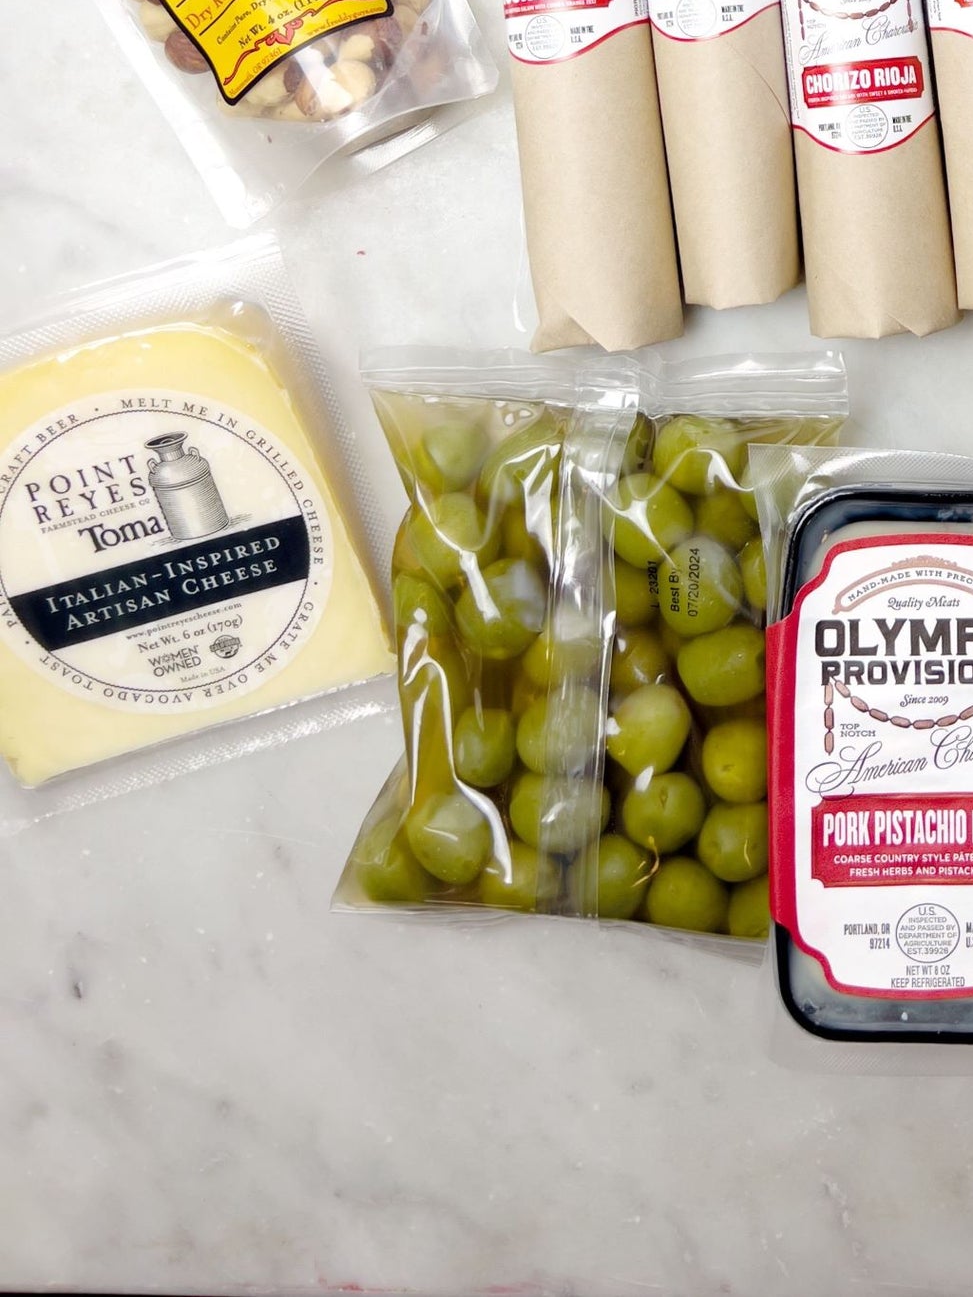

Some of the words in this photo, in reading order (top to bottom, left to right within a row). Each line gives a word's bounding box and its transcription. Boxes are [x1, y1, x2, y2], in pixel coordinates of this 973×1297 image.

[185, 6, 216, 31] Dry
[238, 34, 252, 49] Net
[250, 22, 266, 37] Wt.
[277, 7, 294, 19] oz.
[806, 68, 871, 94] CHORIZO
[874, 65, 917, 88] RIOJA
[121, 397, 172, 409] MELT
[25, 454, 138, 503] POINT
[32, 477, 147, 524] REYES
[78, 515, 165, 553] Toma
[46, 536, 281, 614] ITALIAN-INSPIRED
[688, 548, 700, 617] 07/20/2024
[65, 588, 171, 632] ARTISAN
[182, 558, 279, 597] CHEESE
[887, 597, 923, 611] Quality
[925, 597, 960, 608] Meats
[125, 601, 243, 641] www.pointreyescheese.com
[823, 811, 871, 847] PORK
[874, 808, 968, 846] PISTACHIO
[834, 854, 873, 864] COARSE
[874, 853, 920, 864] COUNTRY
[922, 853, 951, 863] STYLE
[891, 977, 910, 988] KEEP
[912, 976, 965, 988] REFRIGERATED
[906, 965, 920, 975] NET
[921, 965, 934, 975] WT
[934, 965, 939, 975] 8
[940, 965, 950, 975] OZ
